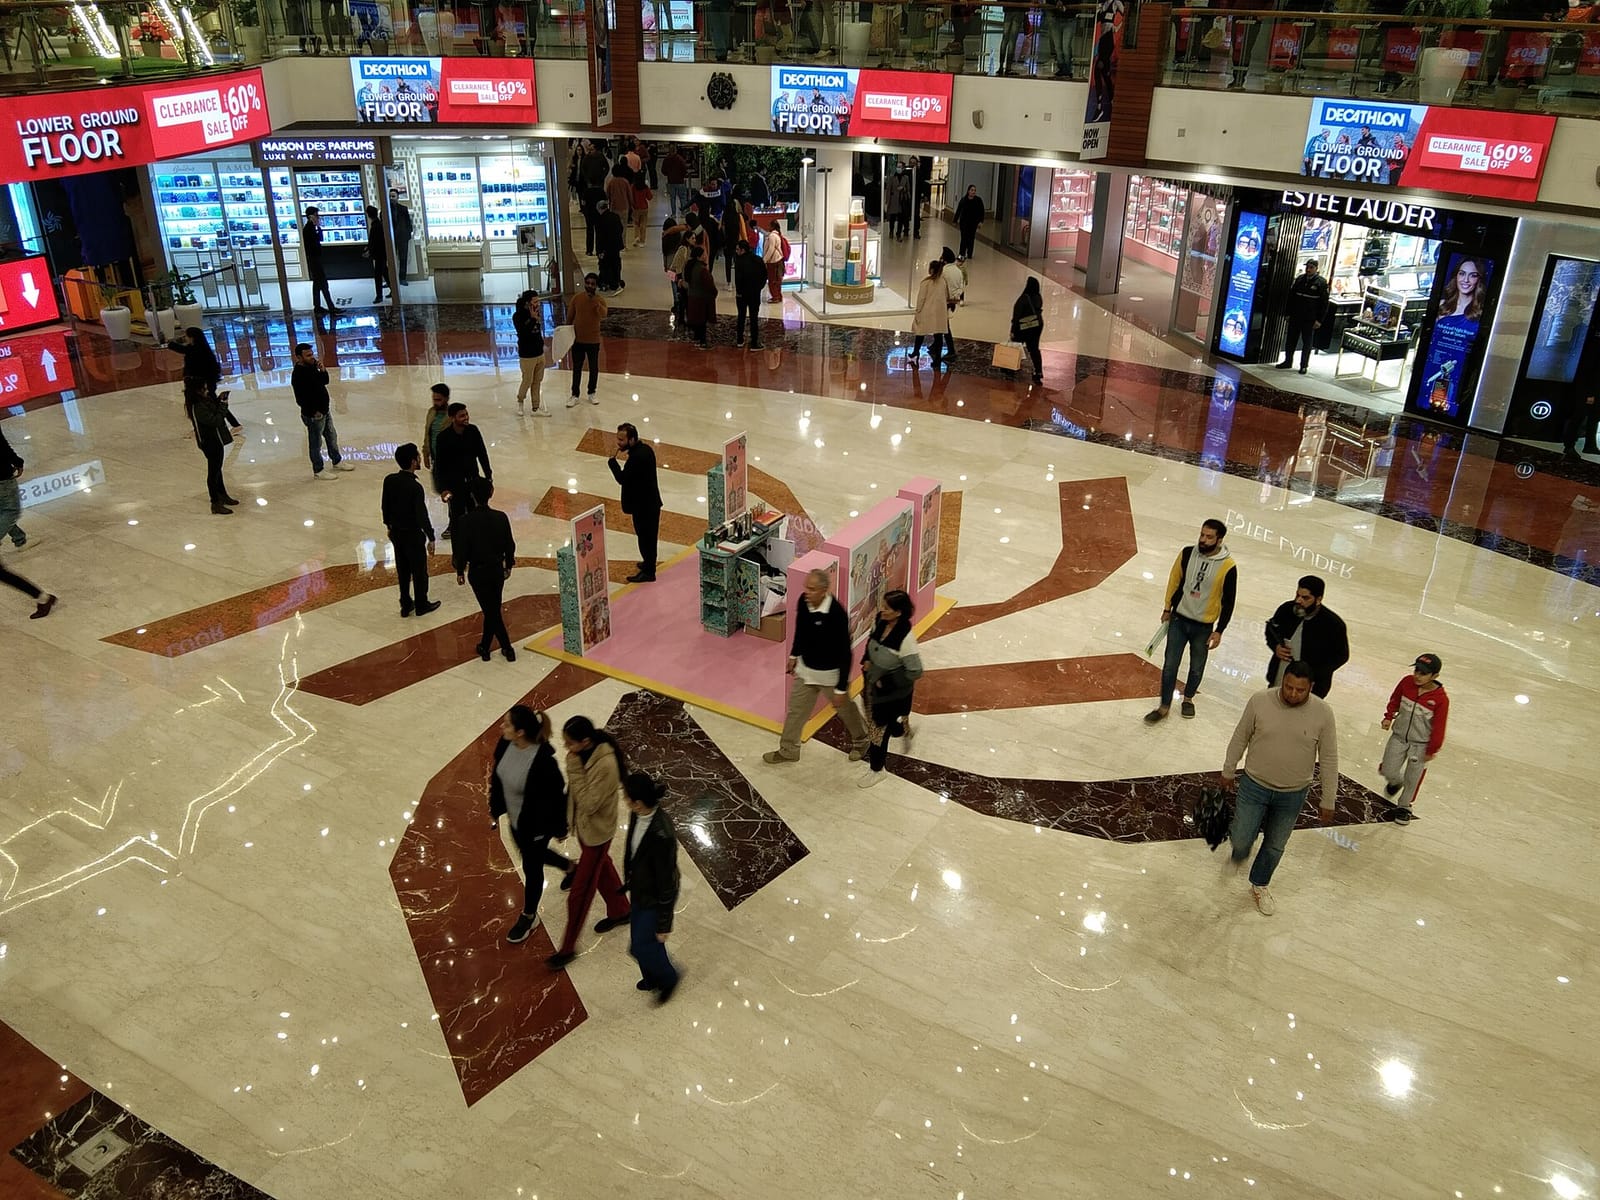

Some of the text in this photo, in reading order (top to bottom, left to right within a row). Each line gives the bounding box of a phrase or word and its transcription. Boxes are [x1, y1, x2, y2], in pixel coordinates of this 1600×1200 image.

[364, 64, 427, 76] DECATHLON
[454, 83, 490, 91] CLEARANCE
[498, 81, 527, 95] 60%
[783, 74, 844, 88] DECATHLON
[227, 84, 261, 116] 60%
[363, 93, 435, 102] LOWER GROUND
[867, 97, 905, 106] CLEARANCE
[912, 97, 942, 112] 60%
[159, 97, 218, 119] CLEARANCE
[365, 102, 422, 117] FLOOR
[778, 103, 848, 115] LOWER GROUND
[893, 109, 909, 117] SALE
[16, 108, 139, 136] LOWER GROUND
[779, 112, 832, 130] FLOOR
[1325, 107, 1405, 128] DECATHLON
[206, 114, 248, 137] SALE OFF
[1083, 128, 1099, 139] NOW
[22, 128, 123, 167] FLOOR
[262, 141, 375, 151] MAISON DES PARFUMS
[1082, 139, 1099, 150] OPEN
[1314, 143, 1404, 160] LOWER GROUND
[1433, 141, 1482, 154] CLEARANCE
[263, 153, 286, 161] LUXE
[325, 152, 376, 160] FRAGRANCE
[1492, 144, 1533, 163] 60%
[1311, 154, 1382, 177] FLOOR
[1464, 156, 1510, 169] SALE OFF
[1345, 196, 1436, 230] LAUDER
